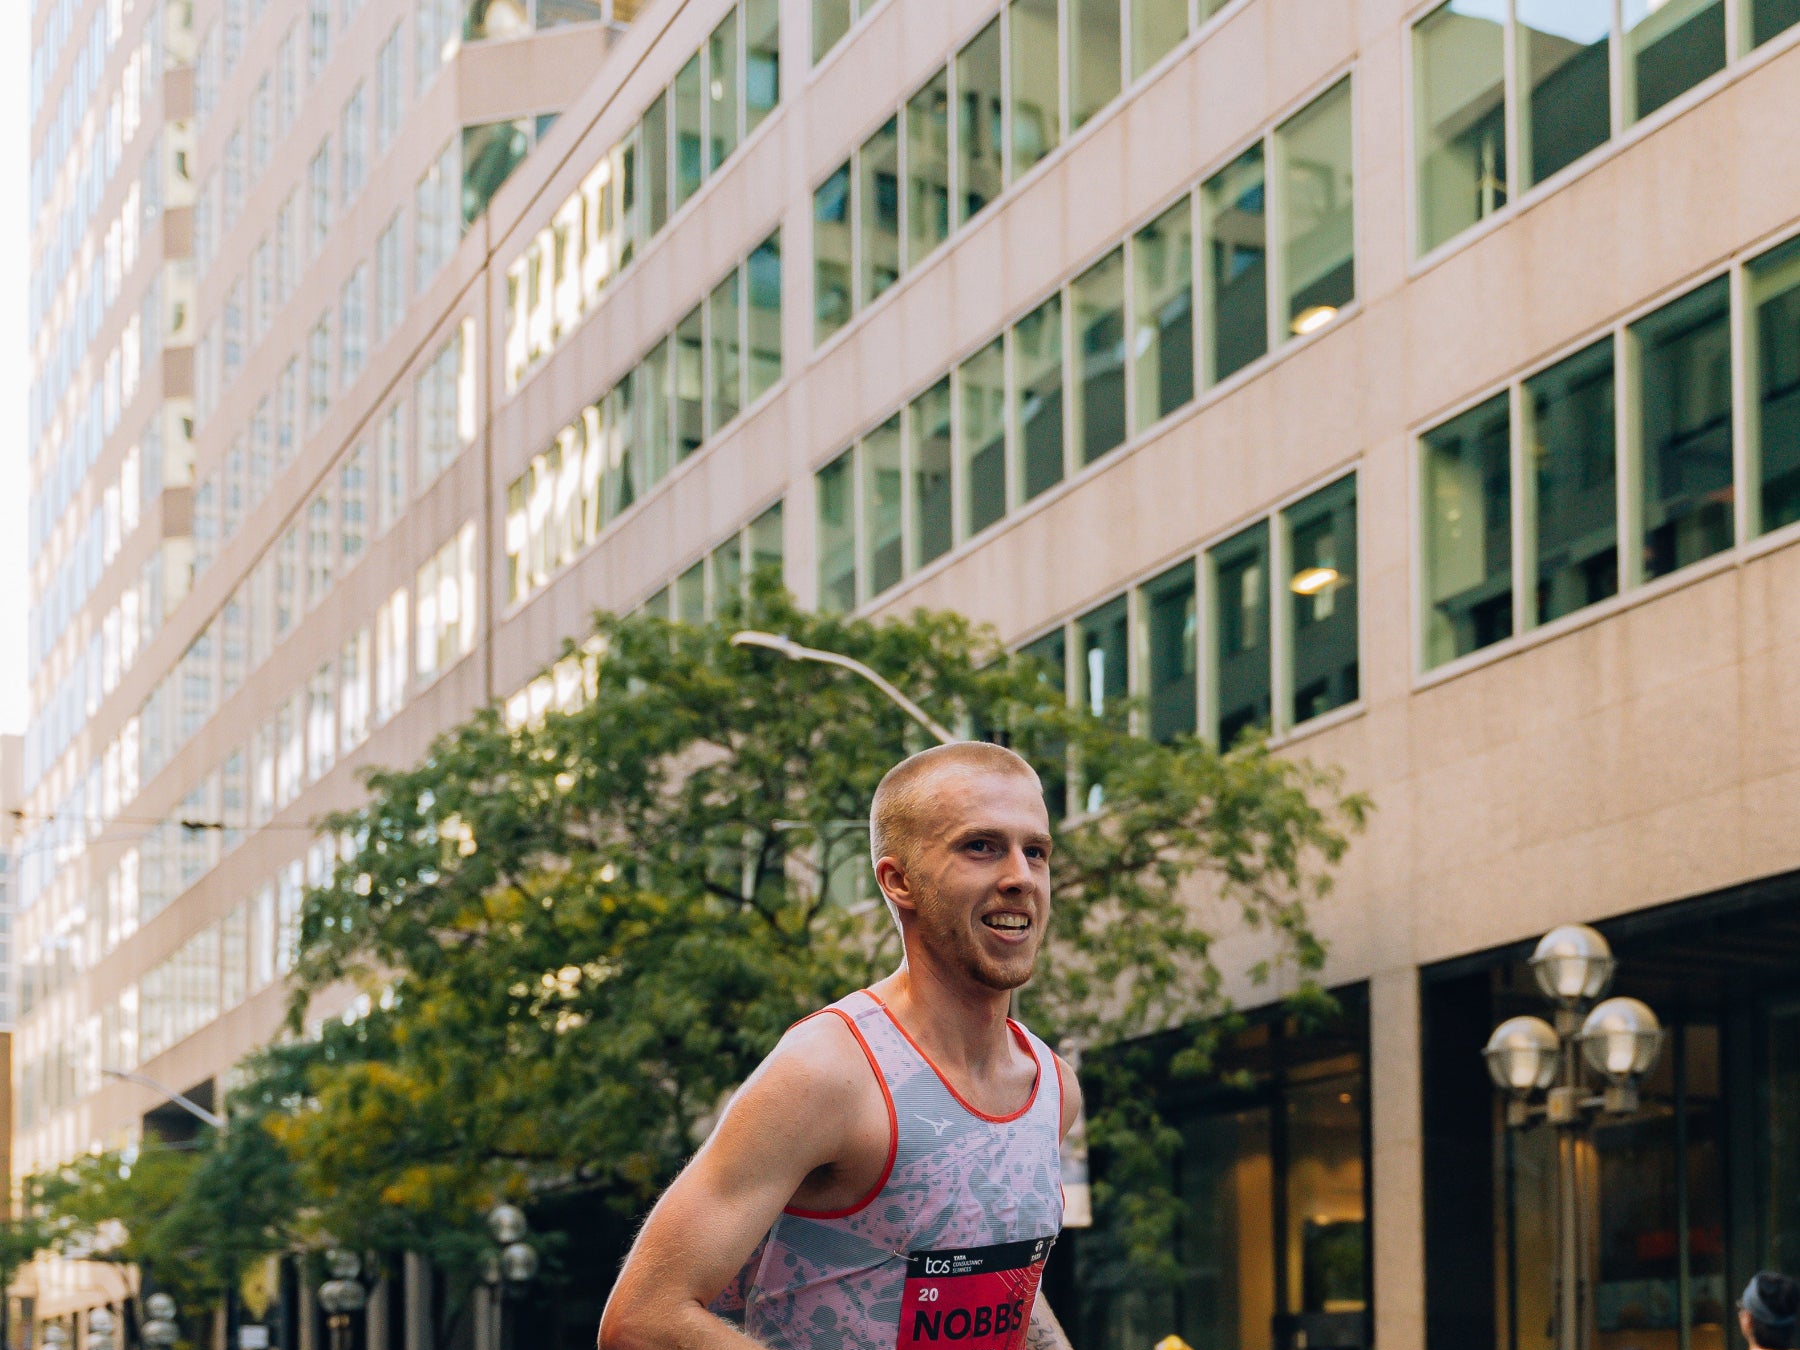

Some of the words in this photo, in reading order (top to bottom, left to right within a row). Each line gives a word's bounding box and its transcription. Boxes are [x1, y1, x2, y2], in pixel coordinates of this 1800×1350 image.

[925, 1256, 951, 1274] tcs
[953, 1259, 983, 1268] CONSULTANCY
[918, 1287, 939, 1302] 20
[912, 1299, 1024, 1341] NOBBS
